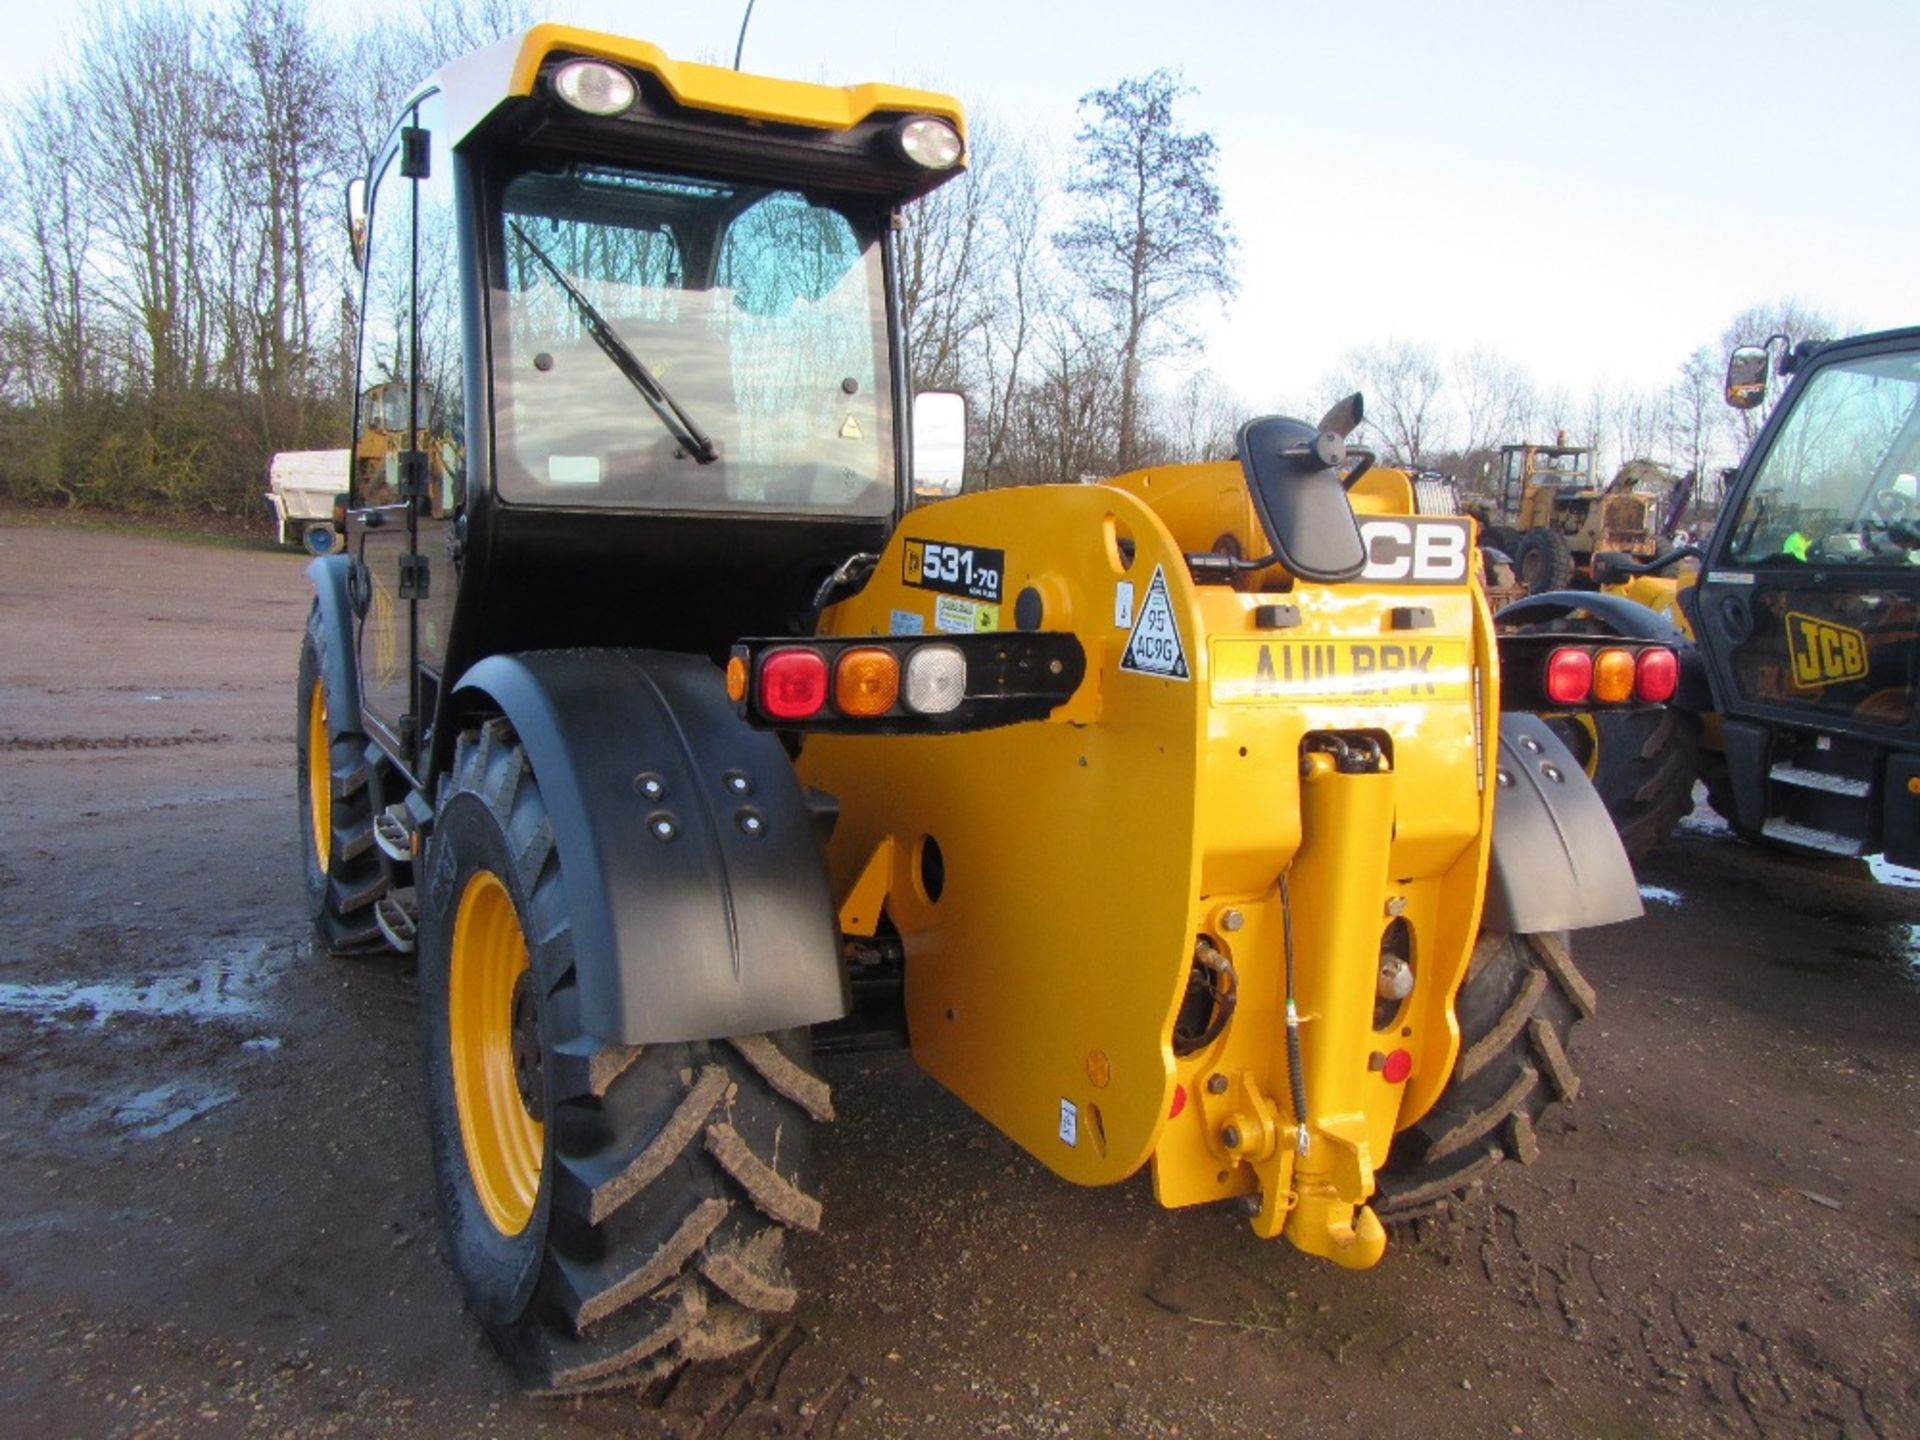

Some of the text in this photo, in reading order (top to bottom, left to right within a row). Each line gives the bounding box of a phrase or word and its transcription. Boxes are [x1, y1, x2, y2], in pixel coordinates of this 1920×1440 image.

[1360, 521, 1467, 579] CB
[1148, 609, 1165, 632] 95
[1136, 635, 1172, 661] AC9G
[1798, 621, 1862, 680] JCB
